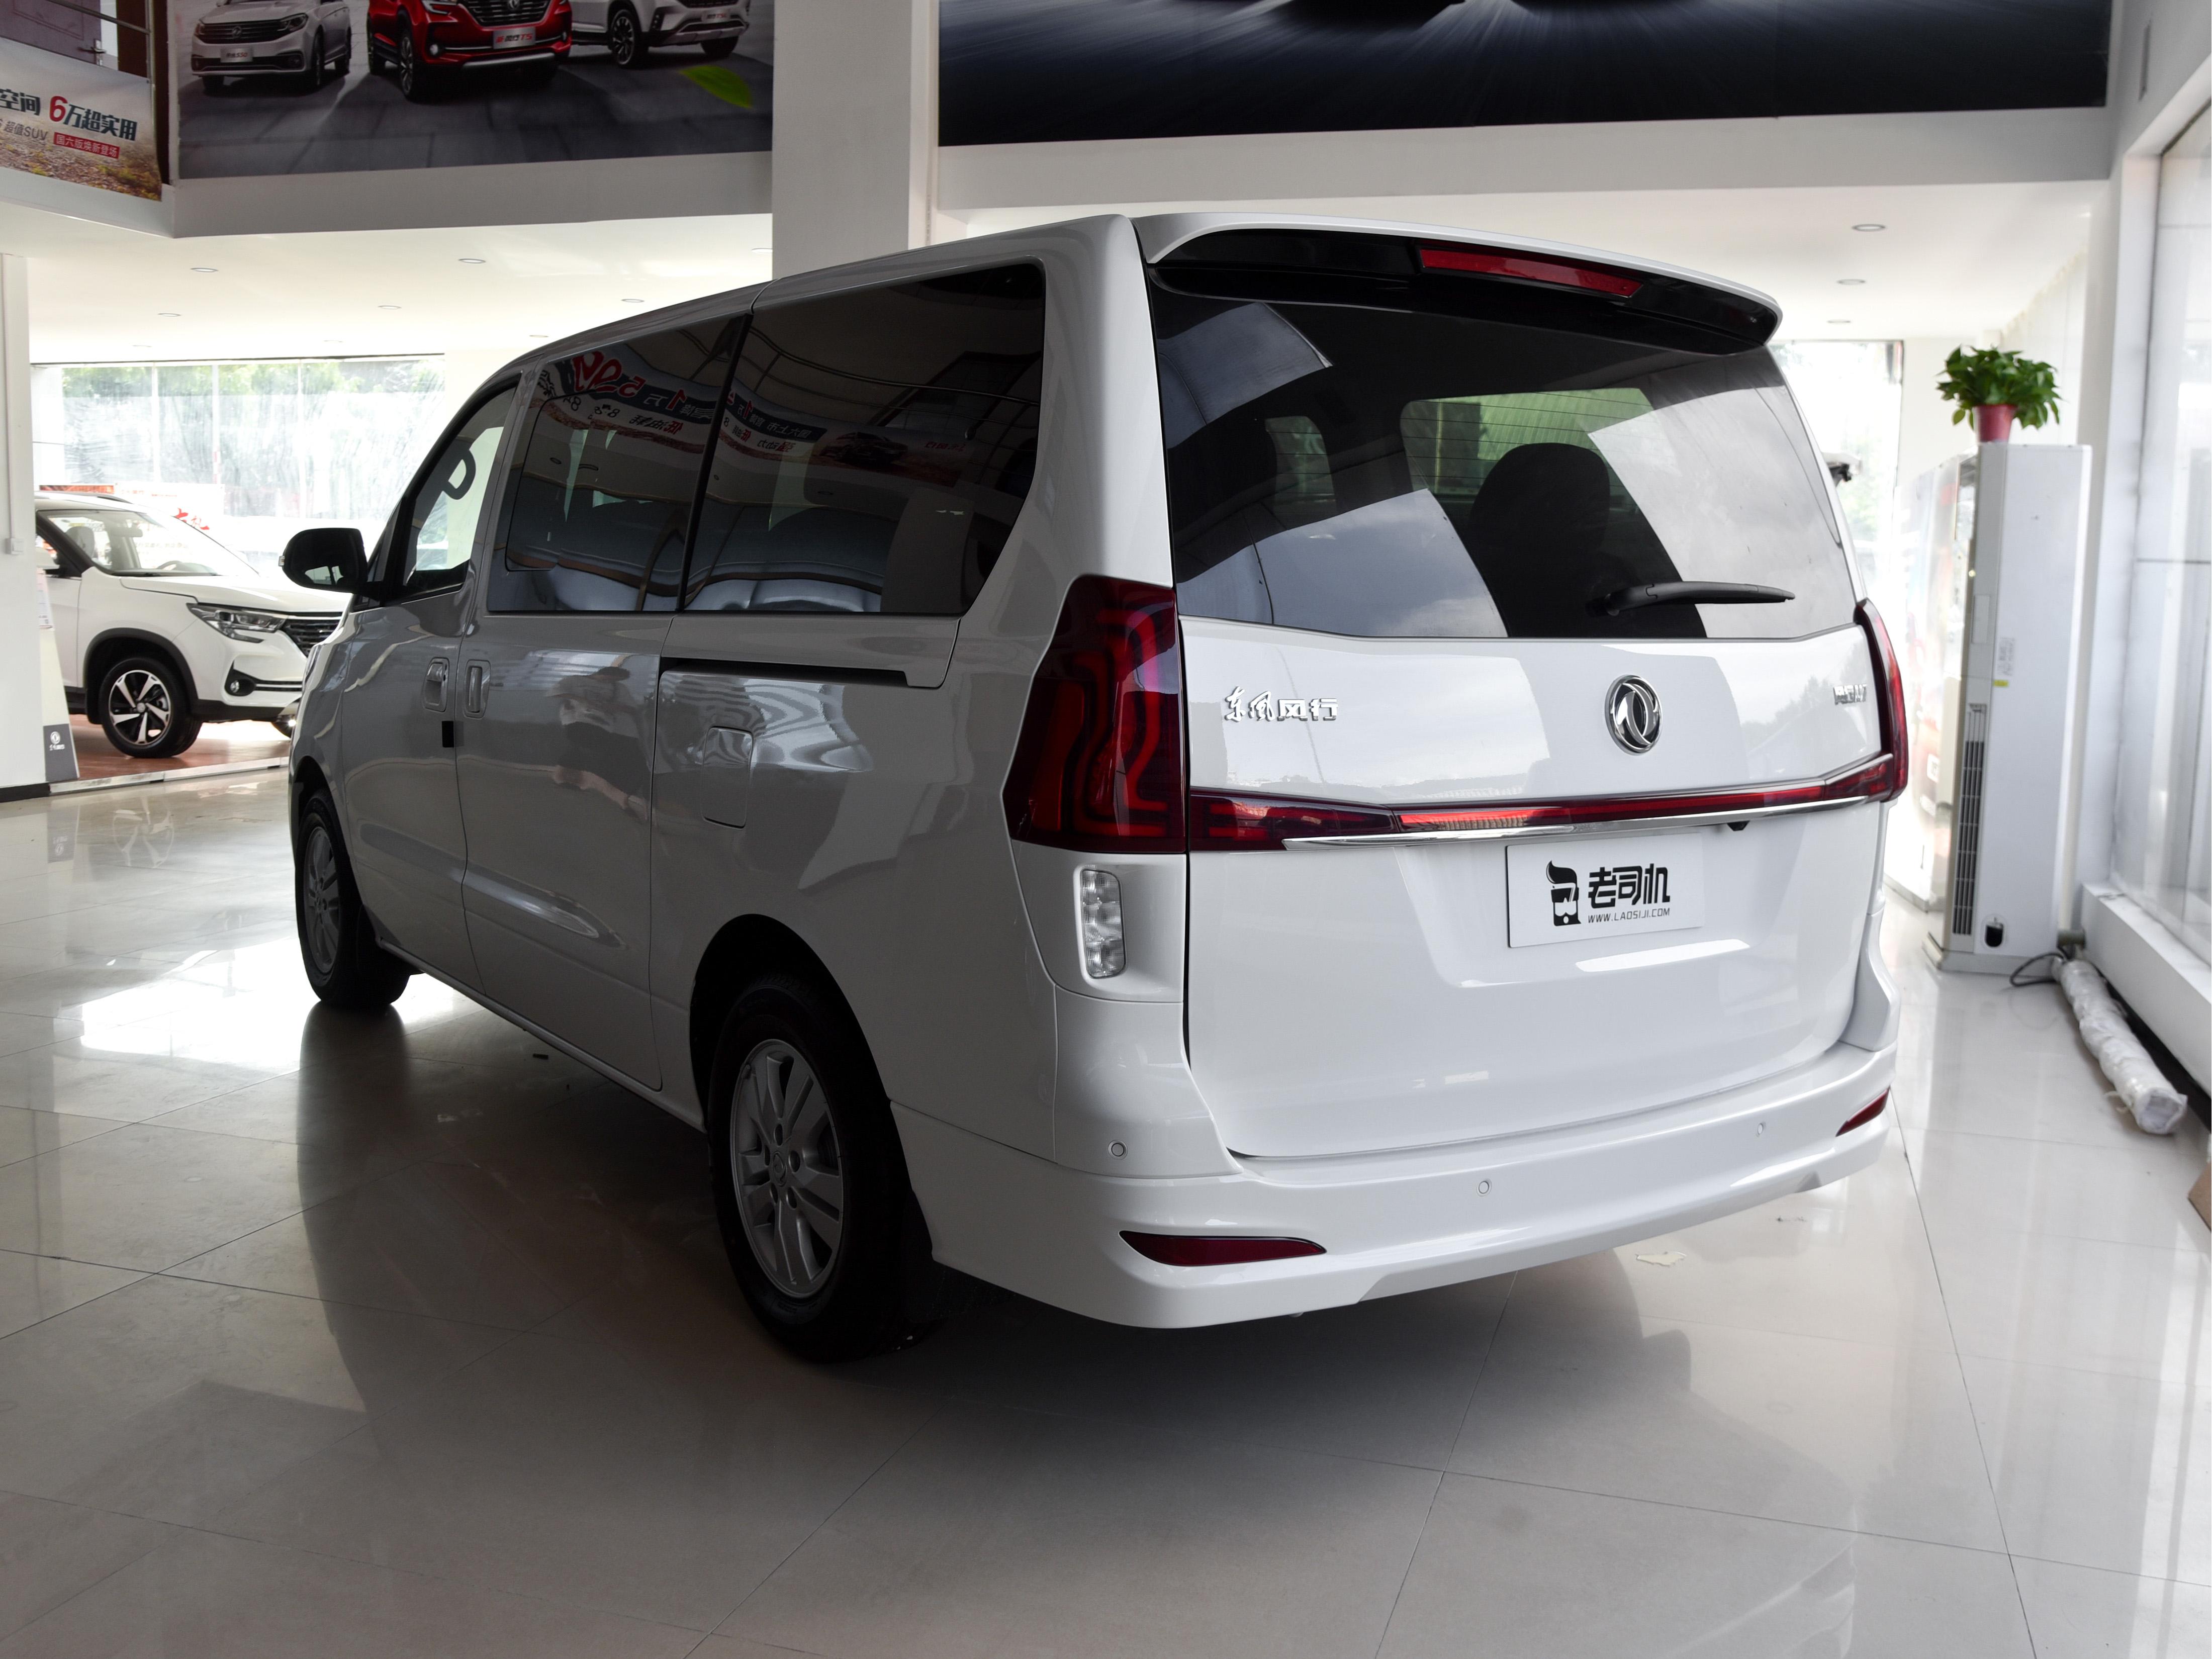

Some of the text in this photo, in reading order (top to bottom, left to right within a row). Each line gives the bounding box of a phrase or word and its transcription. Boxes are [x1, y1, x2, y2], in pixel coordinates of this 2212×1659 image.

[0, 88, 138, 141] 空间 6万超实用
[4, 121, 48, 141] 超值SUV
[55, 134, 119, 158] 国六版焕新登场
[1224, 686, 1338, 721] 东风风行
[1588, 863, 1671, 909] 老司机
[1588, 907, 1670, 924] WWW.LAOSIJI.COM
